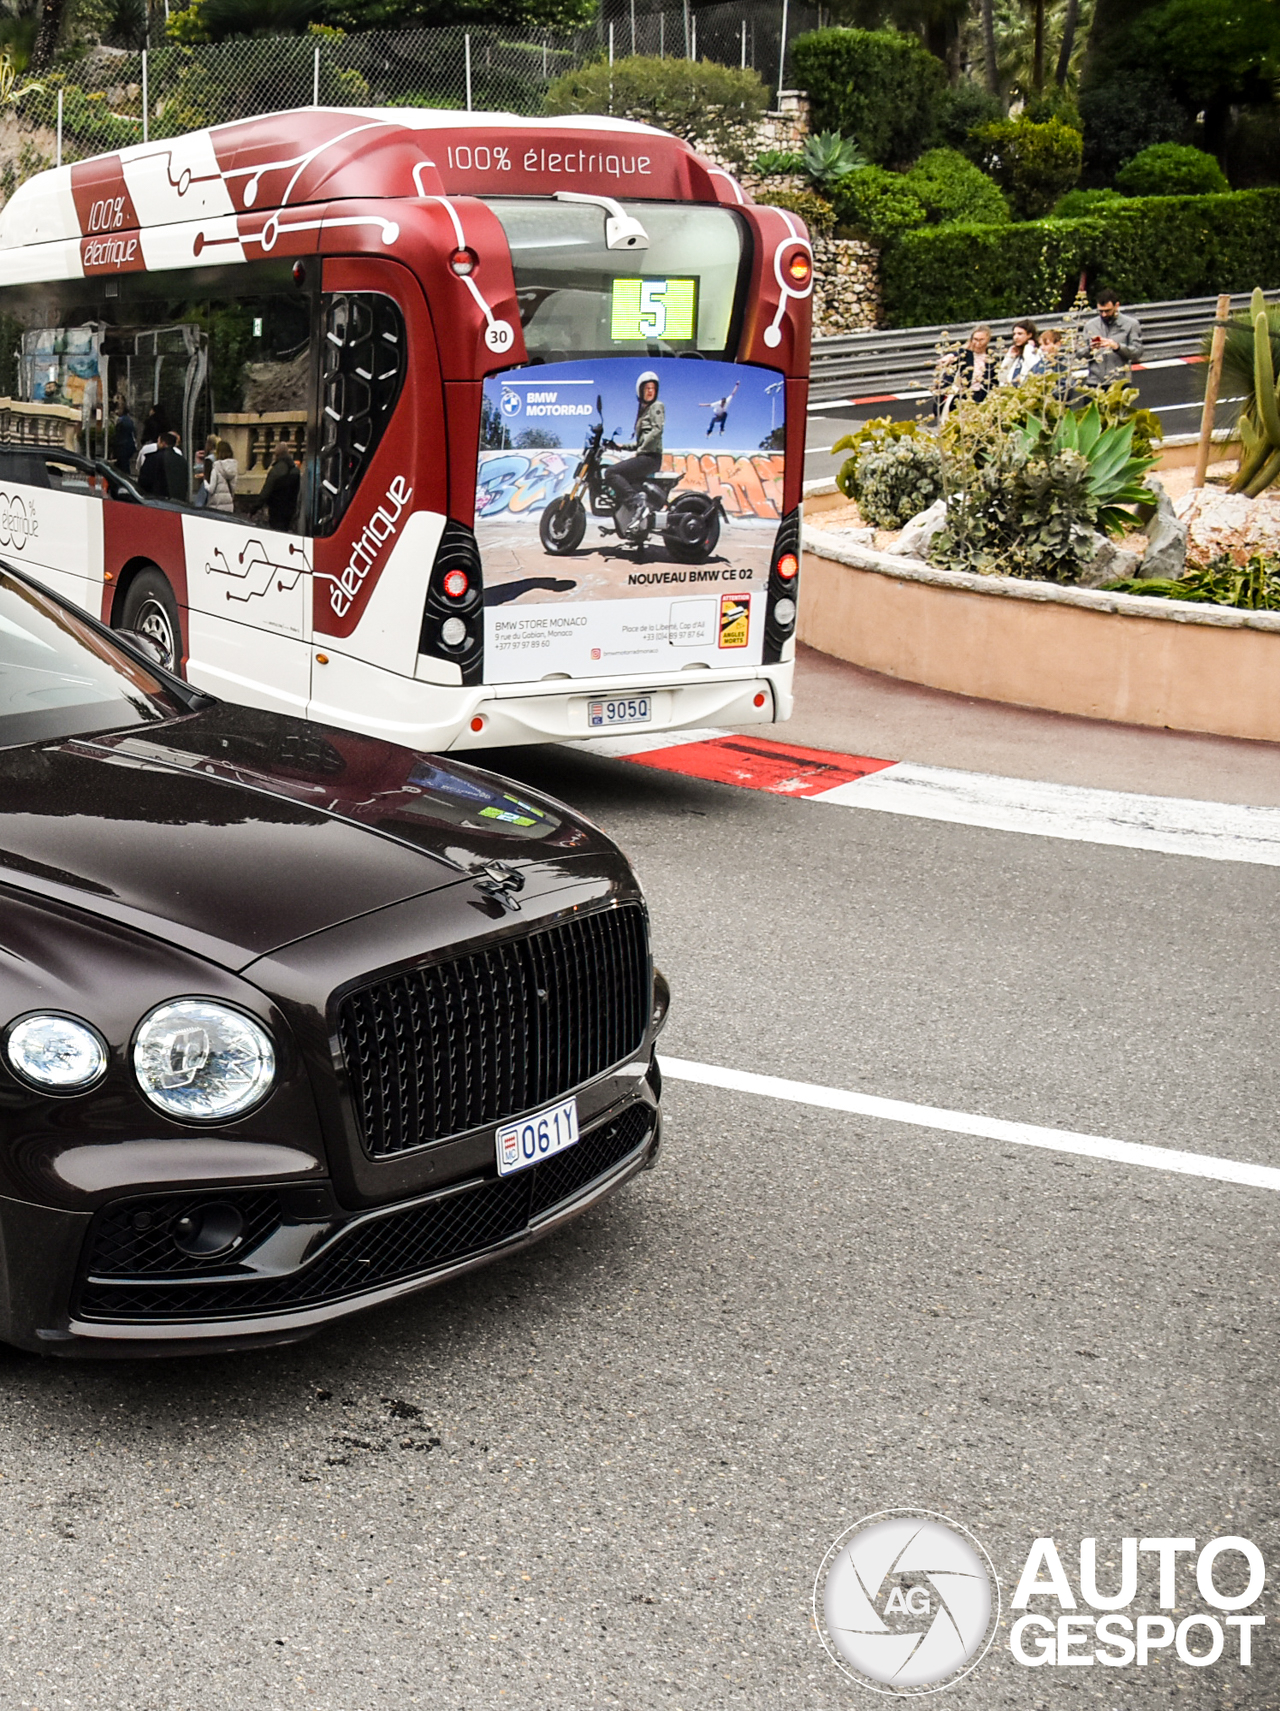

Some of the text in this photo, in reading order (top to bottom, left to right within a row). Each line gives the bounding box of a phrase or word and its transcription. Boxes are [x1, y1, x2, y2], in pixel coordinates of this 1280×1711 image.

[448, 146, 652, 178] 100% électrique
[88, 196, 126, 232] 100%
[84, 238, 137, 268] électrique
[639, 280, 668, 338] 5
[490, 330, 508, 344] 30
[526, 392, 558, 403] BMW
[526, 405, 592, 416] MOTORRAD
[330, 475, 412, 618] électrique
[628, 569, 753, 585] NOUVEAU BMW CE 02
[495, 617, 587, 631] BMW STORE MONACO
[606, 700, 647, 719] 905Q
[522, 1104, 573, 1159] 061Y
[505, 1148, 516, 1159] MC
